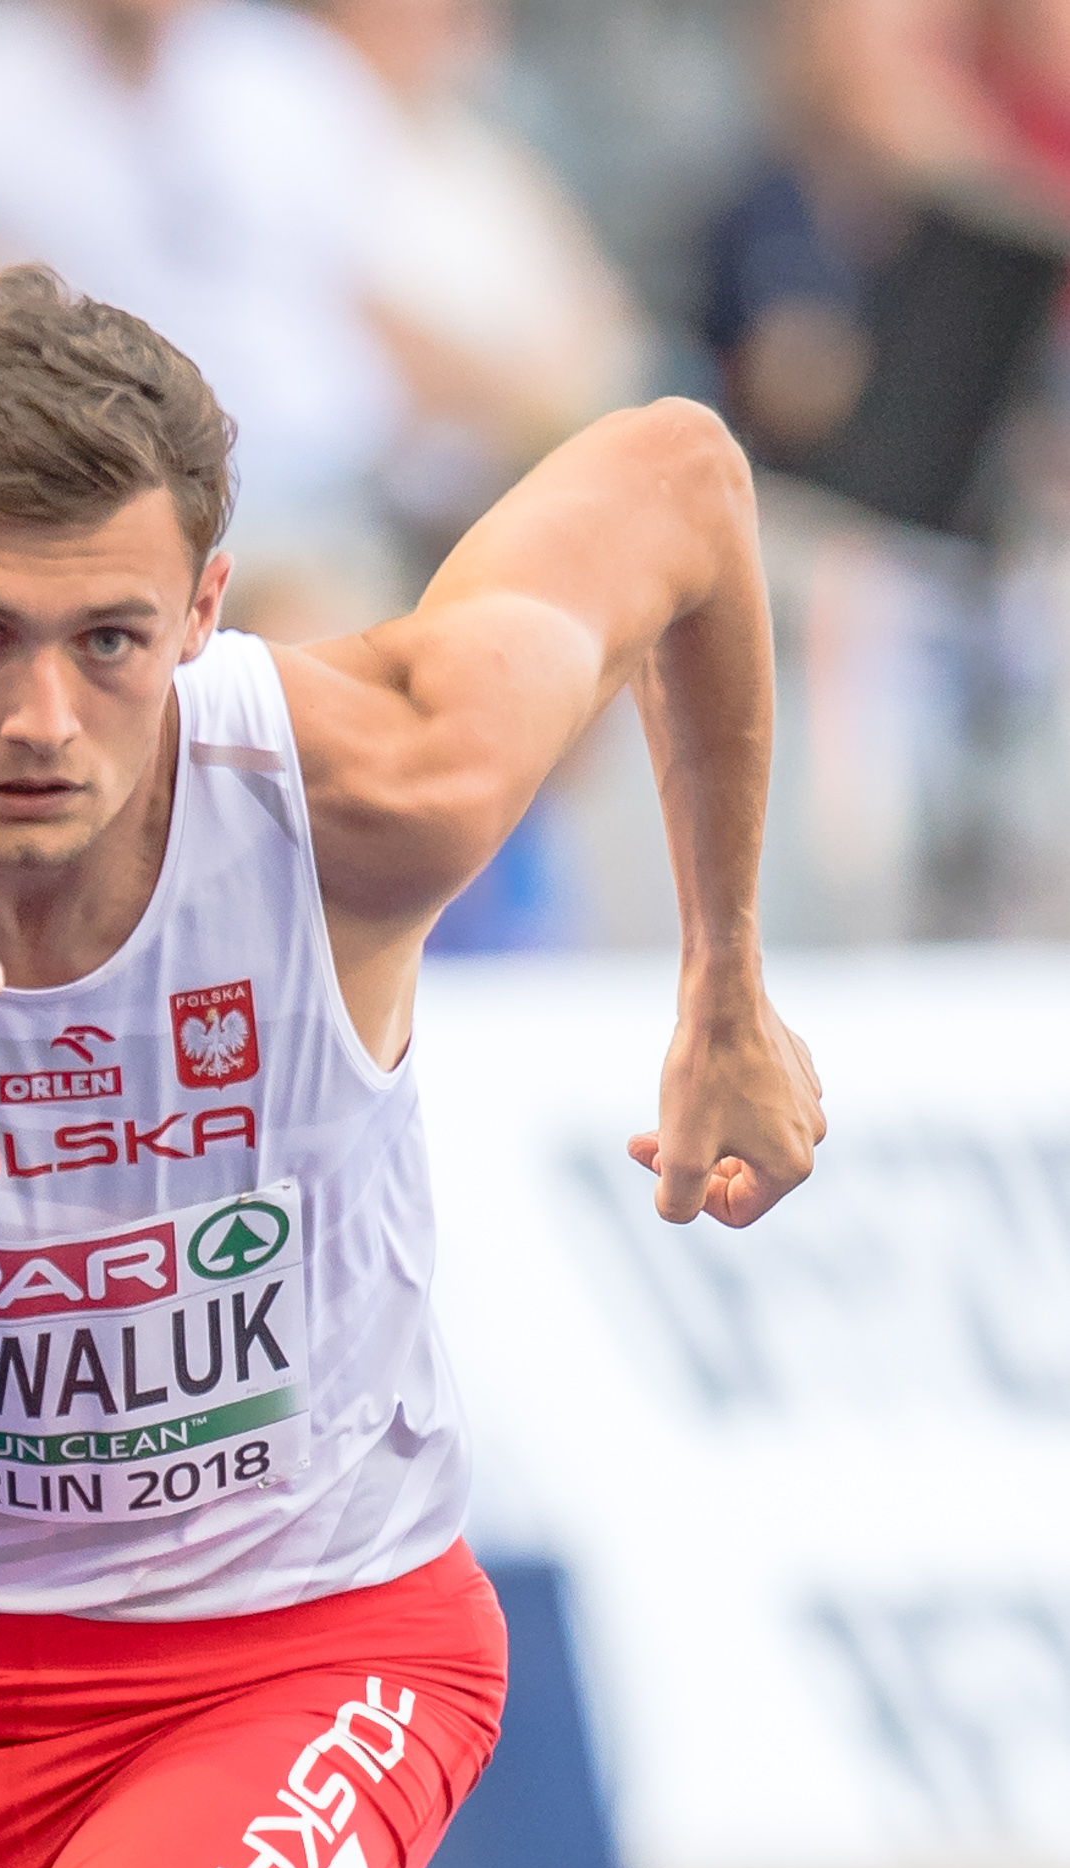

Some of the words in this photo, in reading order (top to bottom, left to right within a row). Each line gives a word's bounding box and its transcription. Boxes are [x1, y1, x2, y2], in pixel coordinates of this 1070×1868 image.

[175, 985, 247, 1010] POLSKA
[3, 1069, 117, 1101] ORLEN
[127, 1440, 271, 1511] 2018
